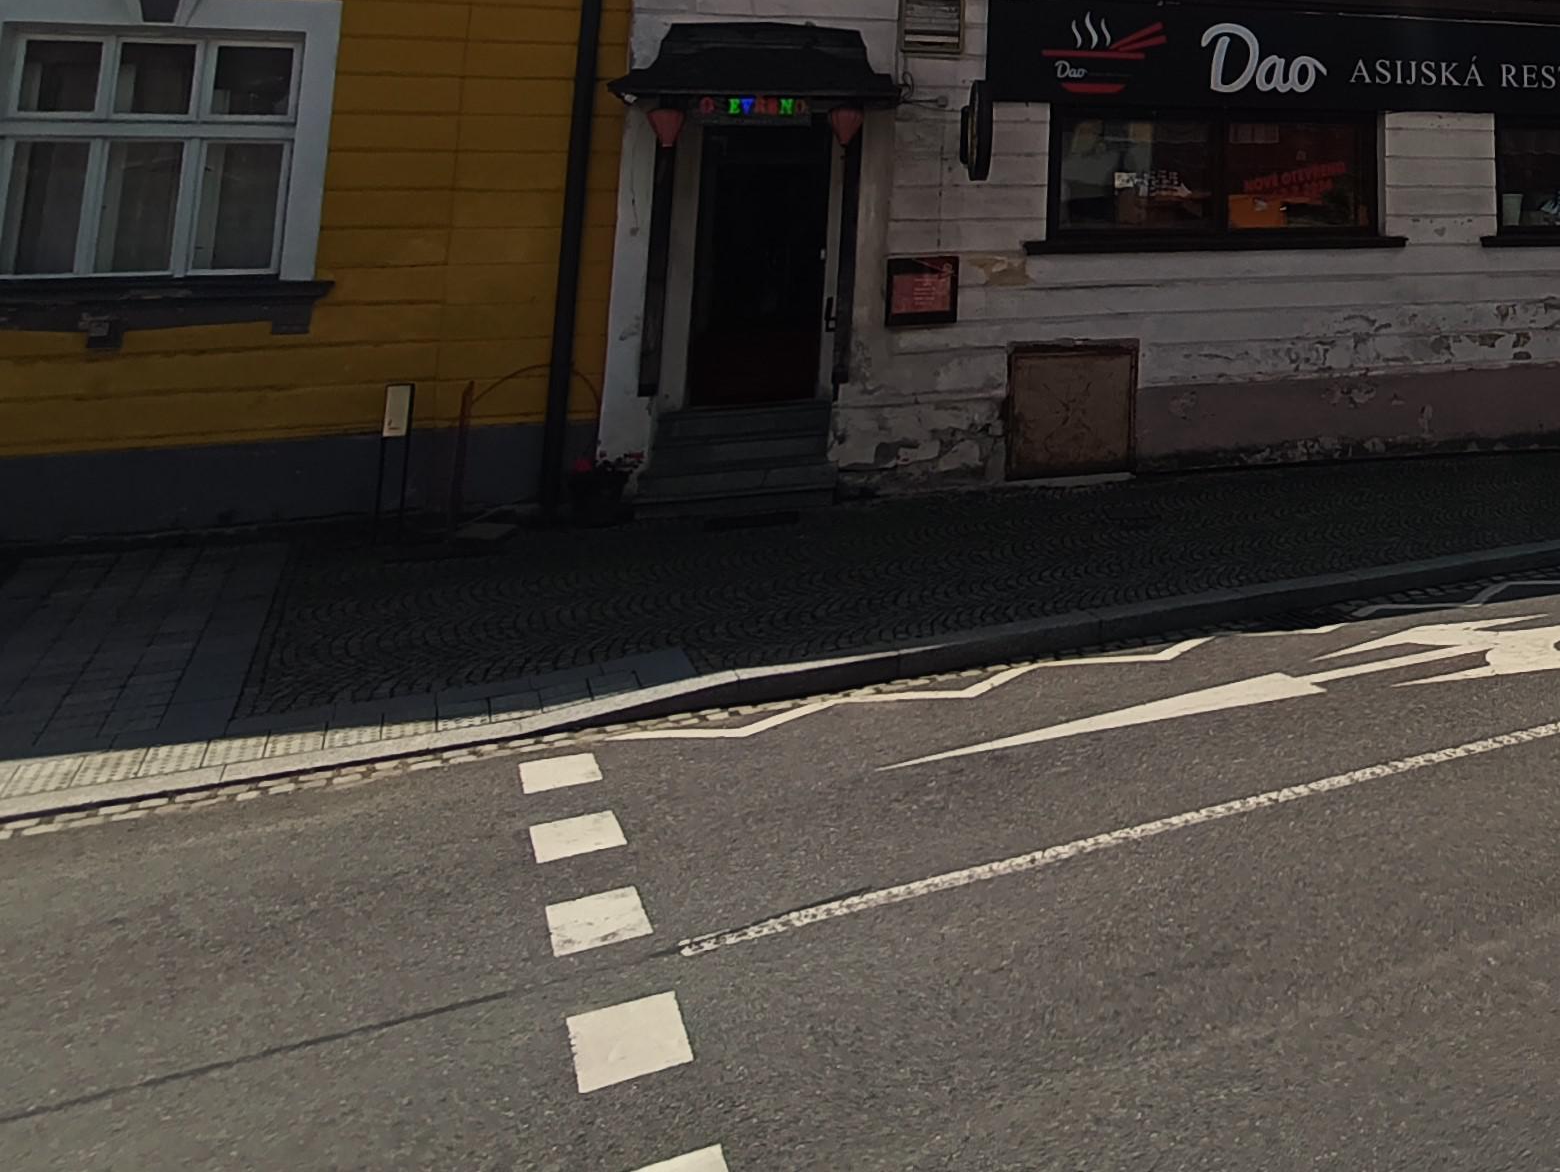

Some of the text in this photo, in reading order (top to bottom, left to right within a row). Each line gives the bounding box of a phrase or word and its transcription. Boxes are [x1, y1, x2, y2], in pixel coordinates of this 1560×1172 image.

[1053, 59, 1088, 79] Dao
[1200, 22, 1328, 94] Dao
[1350, 55, 1485, 87] ASIJSKÁ
